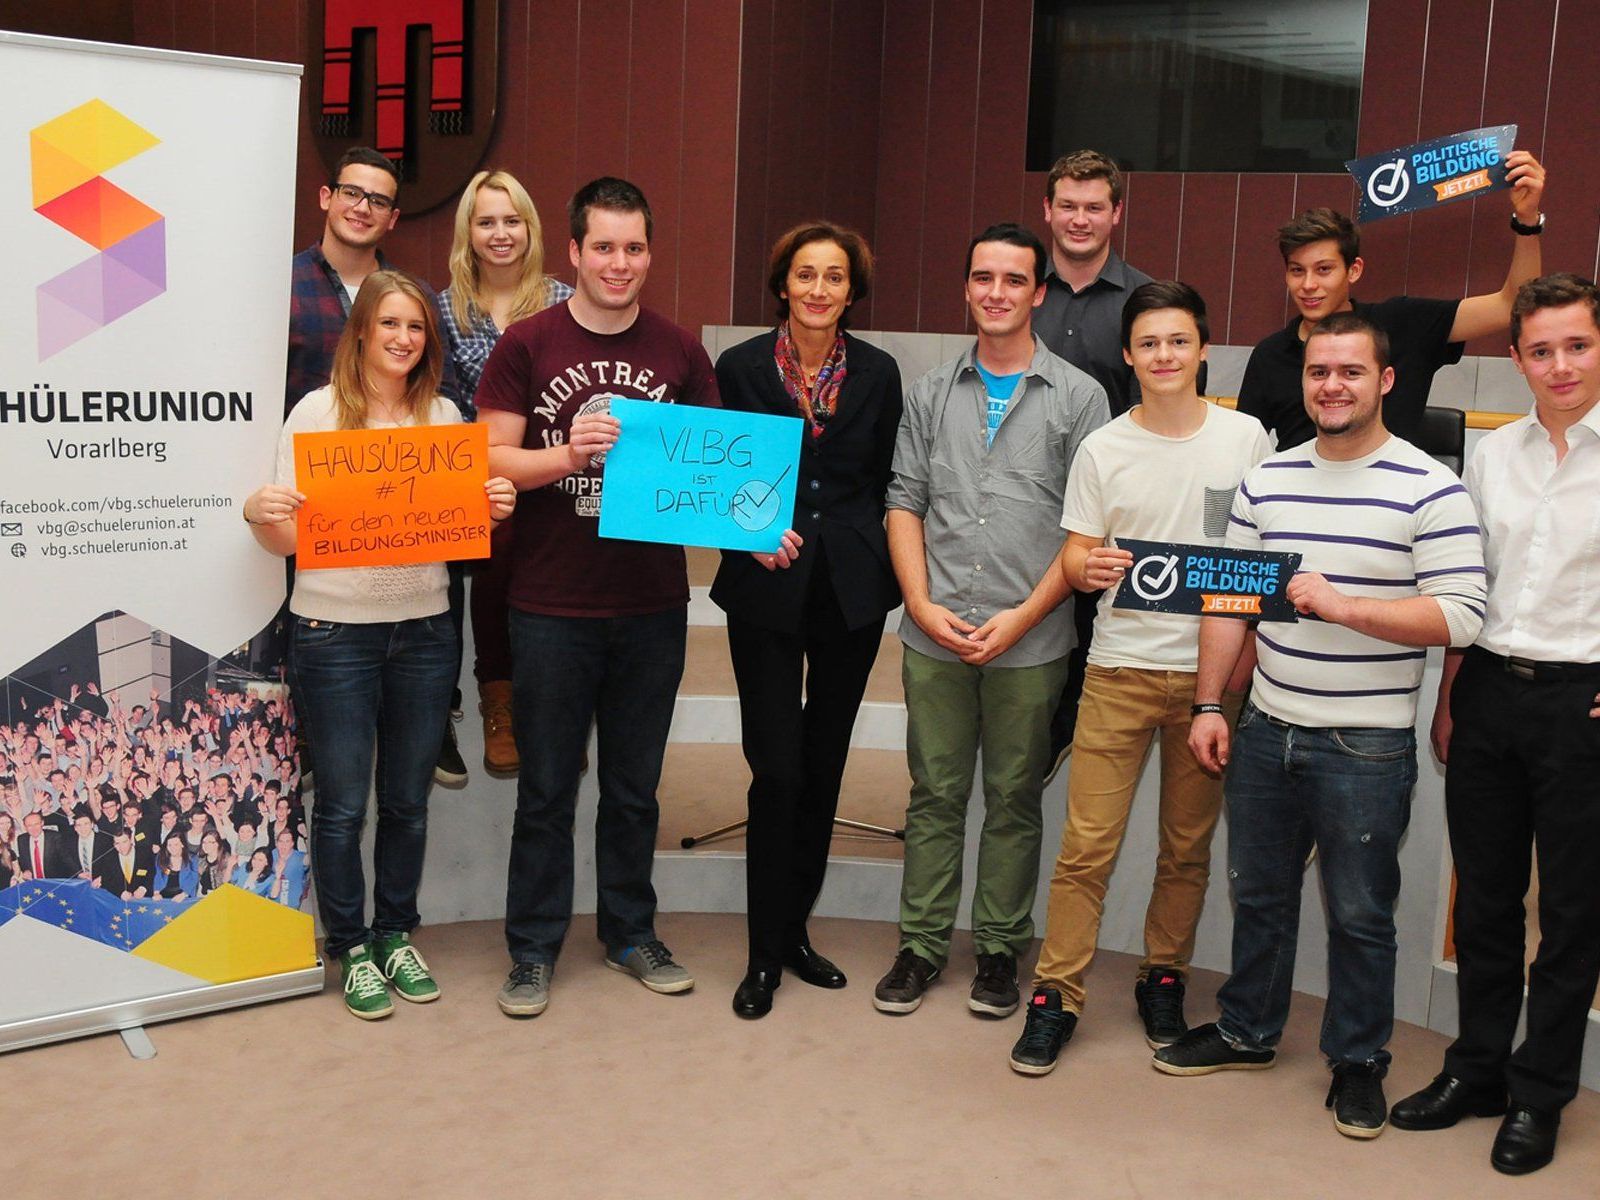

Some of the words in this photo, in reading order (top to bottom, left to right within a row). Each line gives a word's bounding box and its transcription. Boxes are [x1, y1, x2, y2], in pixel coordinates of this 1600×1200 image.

[1412, 137, 1498, 167] POLITISCHE
[1416, 150, 1500, 185] BILDUNG
[1443, 176, 1484, 197] JETZT!
[0, 384, 252, 423] HÜLERUNION
[533, 361, 675, 423] MONTREA
[47, 438, 167, 462] Vorarlberg
[307, 435, 472, 478] HAUSÜBUNG
[659, 426, 752, 468] VLBG
[554, 476, 602, 496] OPE
[692, 473, 717, 485] IST
[0, 494, 232, 514] facebook.com/vbg.schuelerunion
[656, 489, 751, 519] DAFÜR
[37, 517, 195, 537] vbg@schuelerunion.at
[307, 513, 342, 533] für
[351, 511, 394, 532] den
[404, 507, 466, 526] neuen
[41, 537, 188, 558] vbg.schuelerunion.at
[314, 525, 488, 555] BILDUNGSMINISTER
[1186, 556, 1280, 576] POLITISCHE
[1186, 571, 1278, 595] BILDUNG
[1208, 598, 1255, 611] JETZT!
